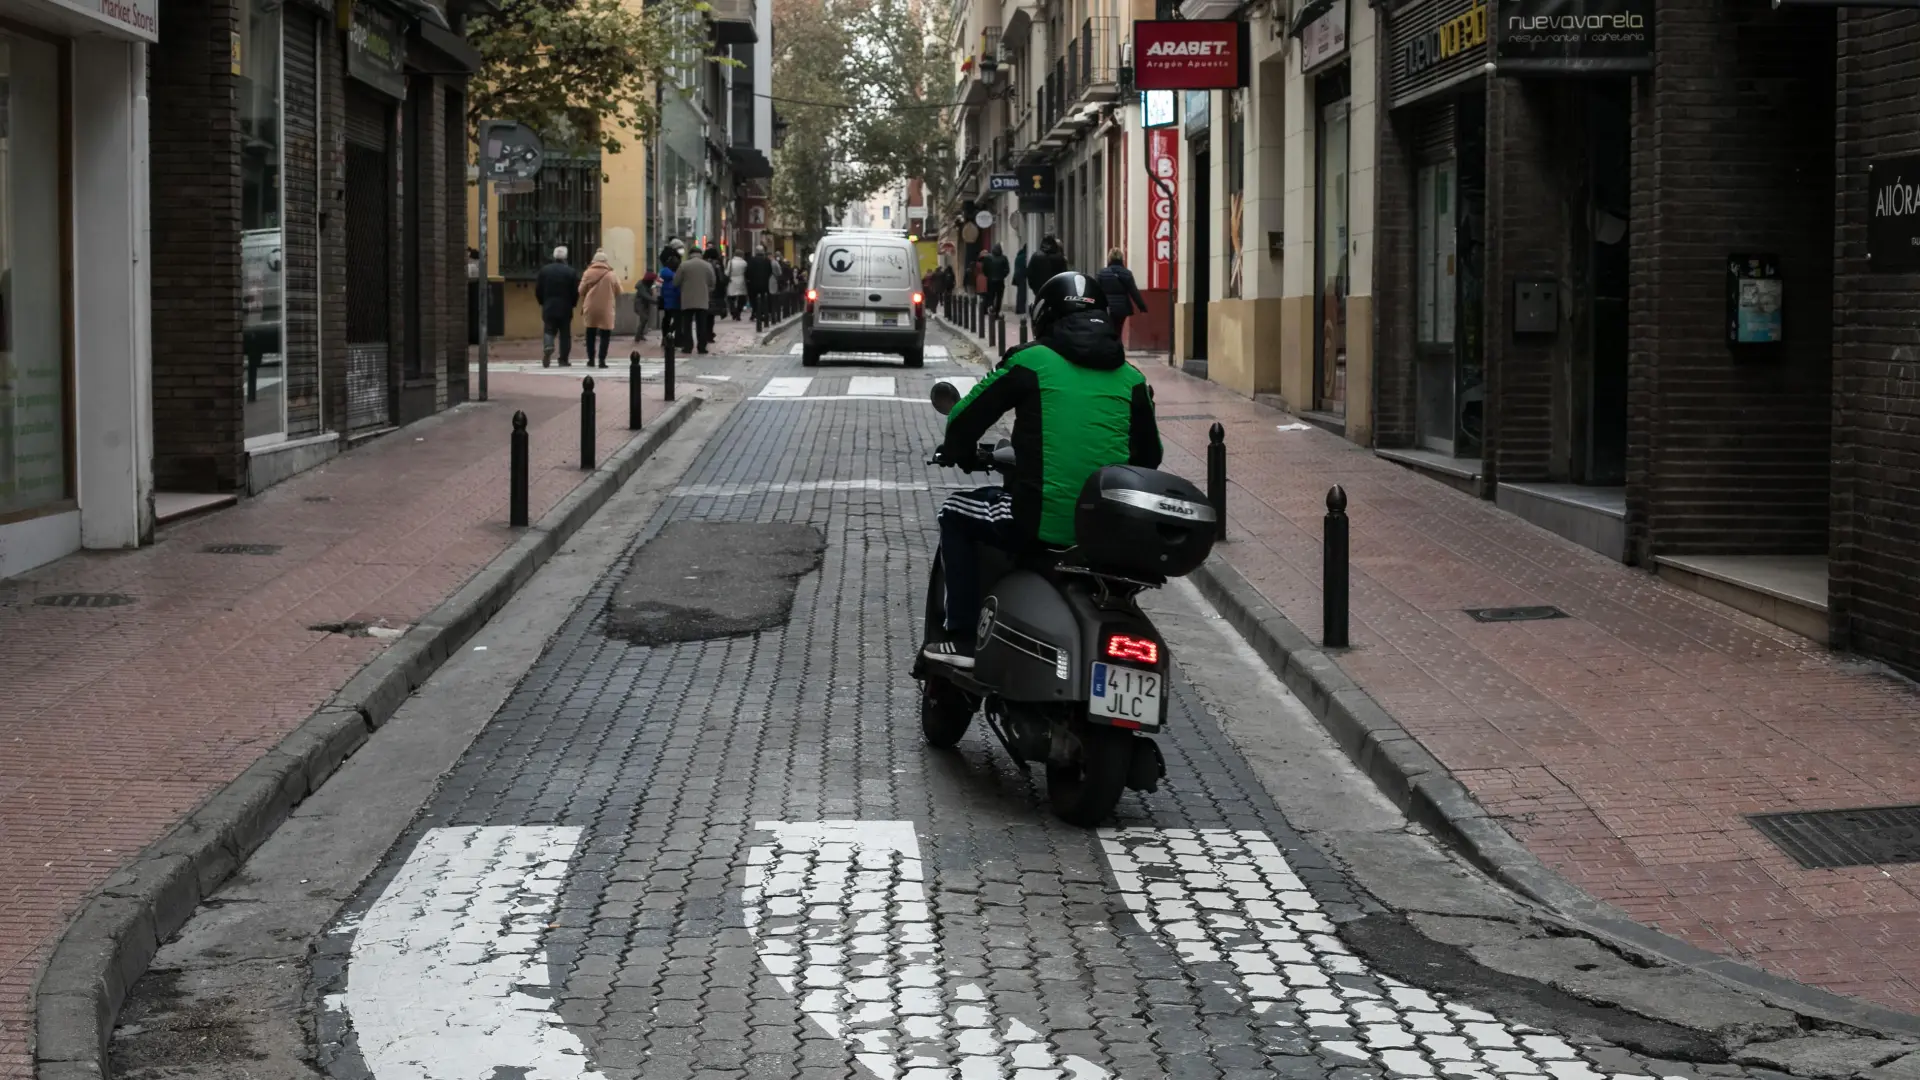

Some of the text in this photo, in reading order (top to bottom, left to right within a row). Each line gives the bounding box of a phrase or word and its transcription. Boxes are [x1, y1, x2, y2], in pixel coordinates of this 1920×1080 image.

[132, 3, 154, 33] Store
[1508, 10, 1645, 30] nuevavarela
[1508, 34, 1579, 43] restaurante
[1146, 60, 1229, 69] Aragón Apuesta
[1155, 157, 1177, 261] BOGAR
[1158, 502, 1194, 515] SHAD
[1108, 669, 1157, 698] 4112
[1106, 692, 1143, 718] JLC
